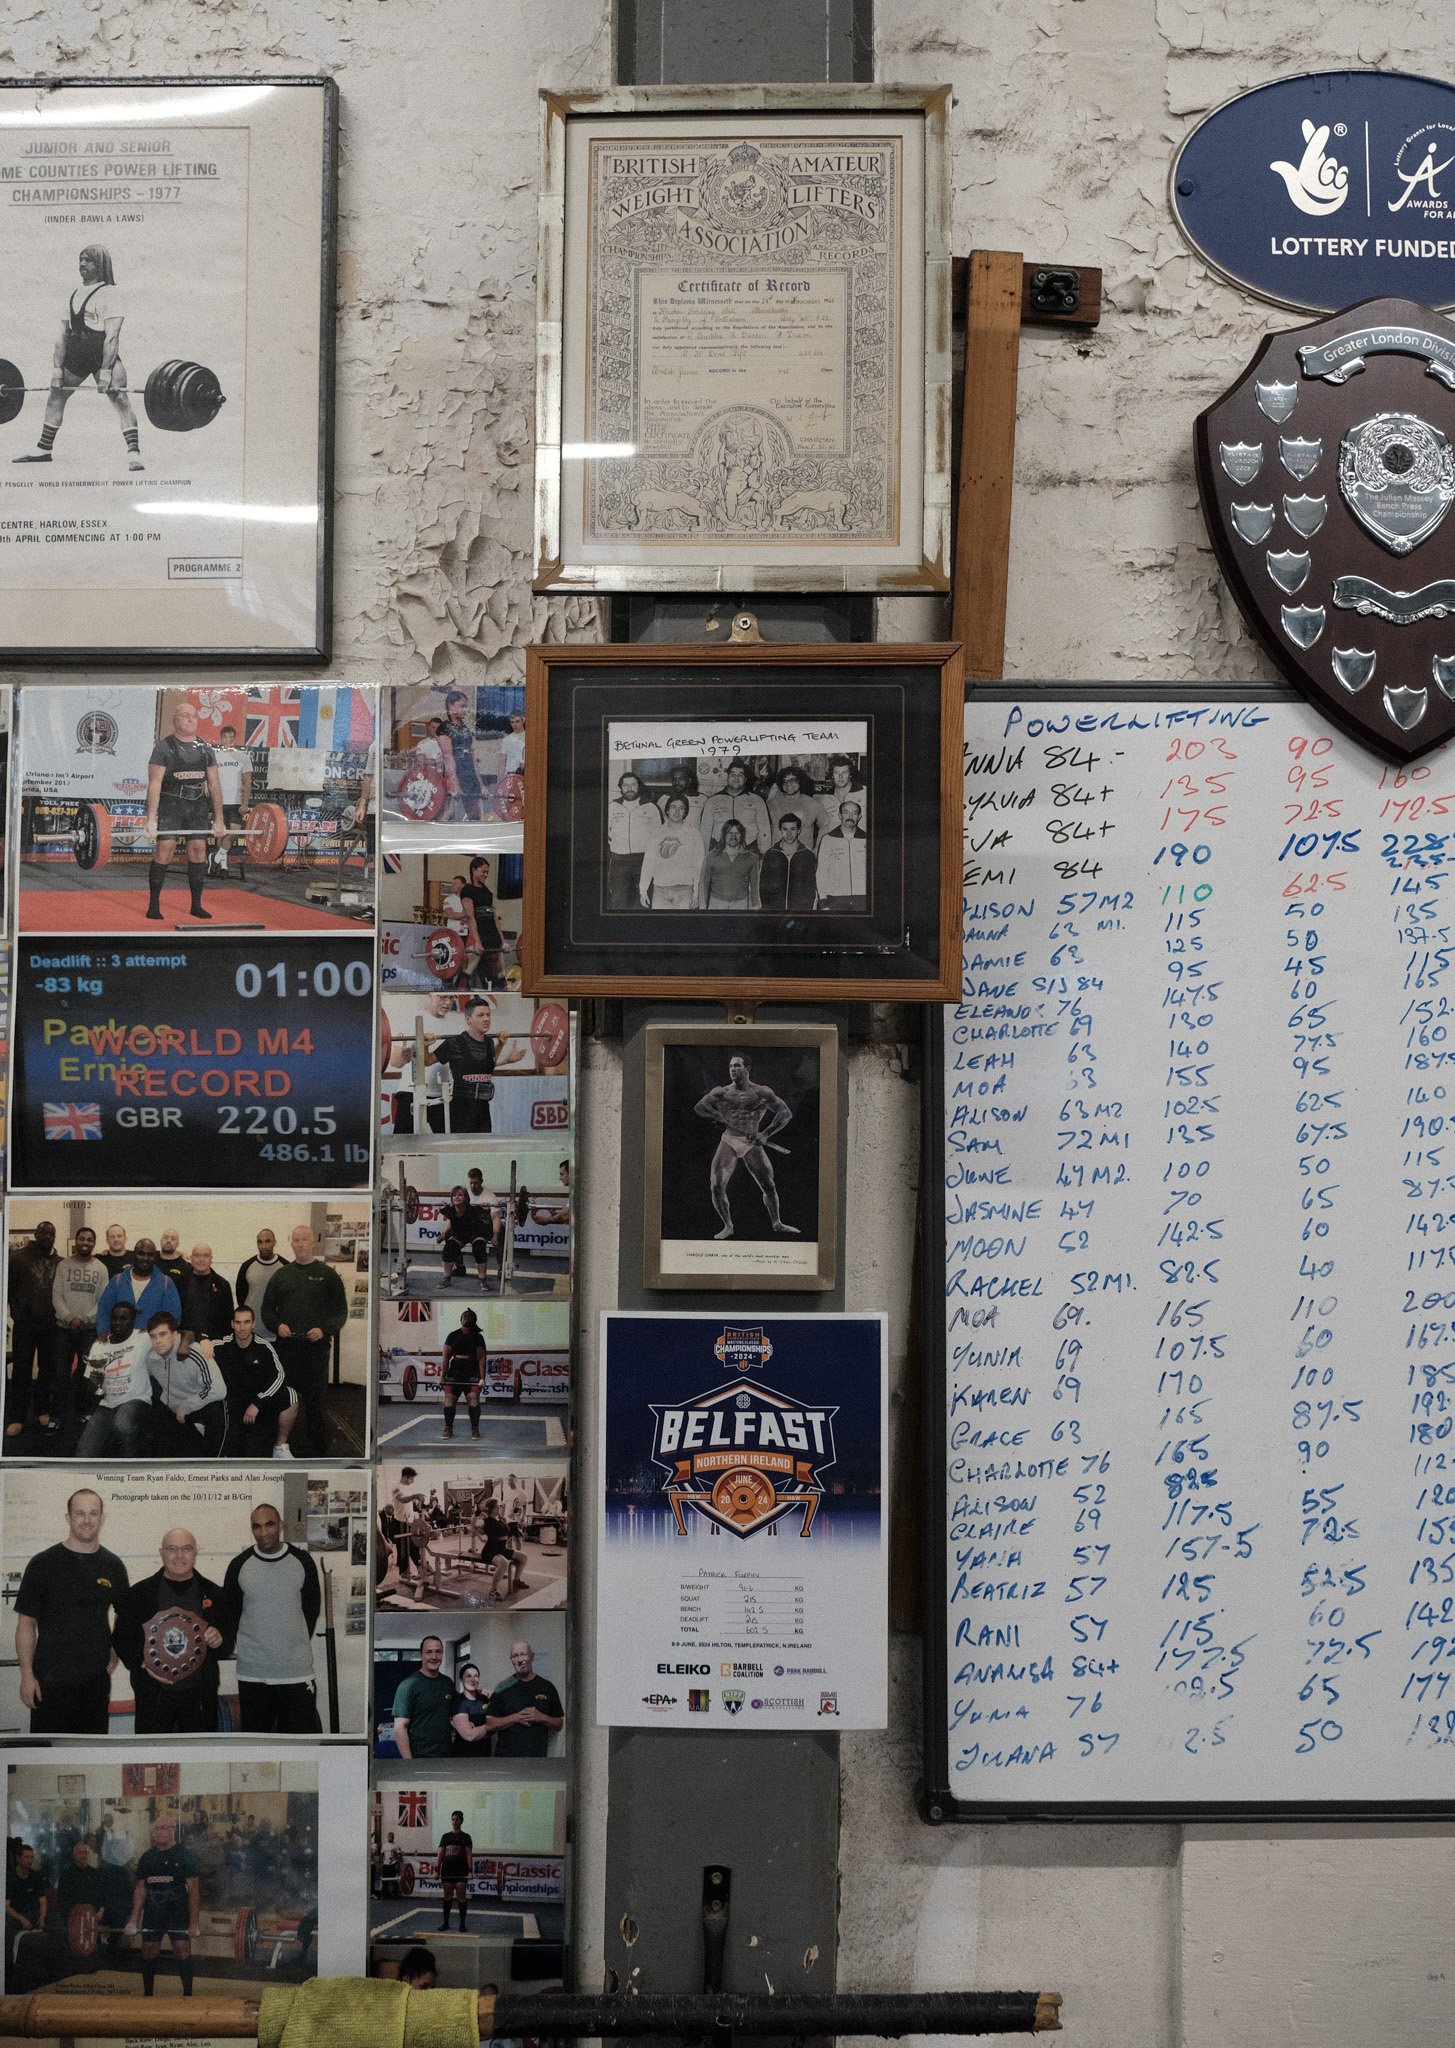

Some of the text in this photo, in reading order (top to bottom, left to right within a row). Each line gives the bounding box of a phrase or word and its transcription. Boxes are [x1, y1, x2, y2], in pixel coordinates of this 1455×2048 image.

[25, 140, 172, 155] JUNIOR AND SENIOR
[29, 162, 218, 179] COUNTIES POWER LIFTING
[613, 156, 881, 175] BRITISH AMATEUR
[12, 186, 181, 202] CHAMPIONSHIPS 1977
[611, 187, 695, 220] WEIGHT
[1406, 200, 1449, 209] AWARDS
[44, 213, 145, 224] (UNDER LAWS)
[1423, 210, 1444, 219] FOR
[678, 214, 810, 255] ASSOCIATION
[1271, 237, 1368, 256] LOTTERY
[677, 278, 811, 293] Certificate of Record
[1323, 332, 1419, 363] Greater London
[61, 480, 109, 488] FEATHERWEIGHT
[160, 479, 192, 487] CHAMPION
[1380, 493, 1433, 503] Julian Massey
[1401, 502, 1422, 510] Press
[40, 519, 110, 530] HARLOW, ESSEX.
[1372, 510, 1428, 519] Championship
[15, 532, 162, 543] APRIL COMMENCING AT PM
[173, 563, 232, 573] PROGRAMME
[1003, 705, 1271, 738] POWERLIFTING
[614, 732, 839, 751] BETHNAL GREEN POWERLIFTING TEAM
[700, 744, 742, 756] 1979
[1166, 736, 1335, 762] 203 90
[1159, 764, 1335, 799] 135 95
[1284, 799, 1344, 825] 72.5
[1153, 842, 1212, 867] 190
[1161, 871, 1450, 906] 110 62.5 145
[1164, 902, 1325, 933] 115 50
[1165, 936, 1204, 953] 125
[30, 954, 187, 970] Deadlift 3 attempt
[1167, 955, 1327, 982] 95 45
[35, 976, 103, 995] -83 kg
[235, 960, 372, 997] 01:00
[1290, 979, 1318, 1000] 60
[952, 999, 1338, 1045] CHARLOTTE 65
[88, 1028, 316, 1057] WORLD M4
[952, 1041, 1098, 1072] LEAH 63
[1165, 1056, 1331, 1088] 155 95
[114, 1069, 293, 1098] RECORD
[115, 1106, 184, 1129] GBR
[534, 1105, 569, 1125] SBD
[950, 1091, 1346, 1128] ALISON 102.5 62.5
[216, 1105, 338, 1136] 220.5
[1166, 1124, 1216, 1144] 135
[258, 1144, 369, 1164] 486.1 lb
[945, 1154, 1331, 1189] JUNE 100 50
[945, 1184, 1341, 1225] JASMINE 70 65
[946, 1216, 1330, 1264] MOON 52 142.5 60
[67, 1268, 100, 1284] 1958
[945, 1254, 1335, 1300] RACHEL 82.5 40
[1156, 1295, 1338, 1328] 165 110
[715, 1344, 772, 1355] CHAMPIONSHIPS
[1155, 1333, 1228, 1362] 107.5
[1290, 1365, 1334, 1390] 100
[659, 1410, 826, 1455] BELFAST
[950, 1420, 1083, 1451] GRACE 63
[696, 1454, 791, 1470] NORTHERN IRELAND
[948, 1457, 1070, 1485] CHARLOTTE
[96, 1474, 260, 1483] Winning Team Ryan Faldo, Ernest Parks and Alan
[734, 1475, 753, 1484] JUNE
[111, 1493, 222, 1502] Photograph taken the 10/11/12
[720, 1495, 768, 1505] 20 24
[1072, 1483, 1345, 1515] 52 55
[950, 1498, 1233, 1541] CLAIRE 117.5
[951, 1571, 1216, 1604] BEATRIZ 57 125
[955, 1614, 1109, 1648] RANI 57
[657, 1663, 711, 1675] ELEIKO
[733, 1663, 763, 1671] BARBELL
[733, 1670, 764, 1678] COALITION
[650, 1693, 672, 1704] EPA
[1298, 1672, 1341, 1706] 65
[764, 1698, 805, 1706] SCOTTISH
[1066, 1691, 1344, 1754] 76 50
